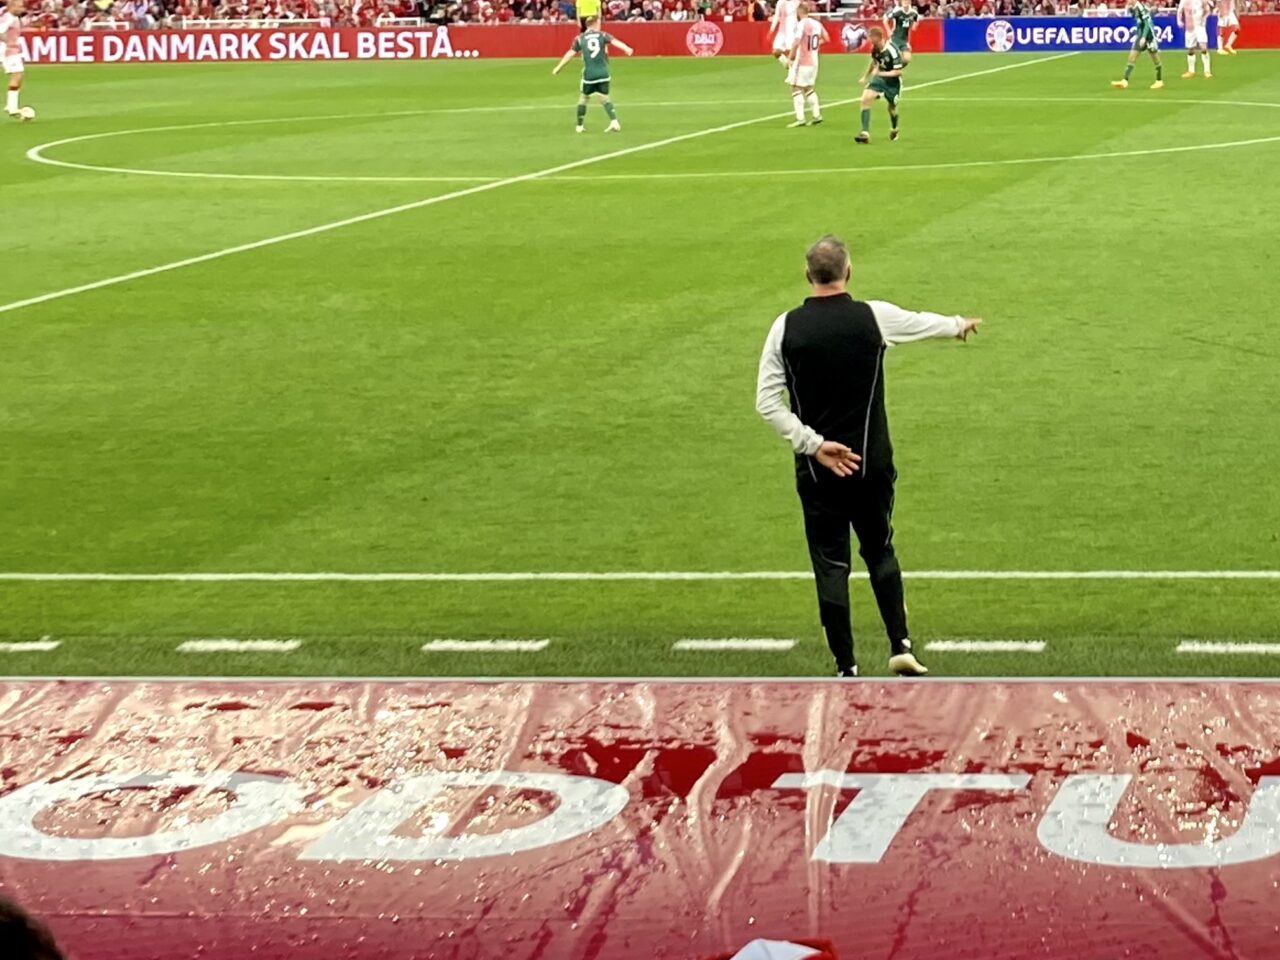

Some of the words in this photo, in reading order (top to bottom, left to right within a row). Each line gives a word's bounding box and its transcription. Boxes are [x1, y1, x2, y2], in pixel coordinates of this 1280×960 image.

[17, 35, 95, 63] AMLE
[103, 33, 262, 62] DANMARK
[269, 31, 349, 59] SKAL
[357, 26, 480, 59] BESTÅ...
[587, 38, 600, 58] 9
[807, 34, 820, 51] 10
